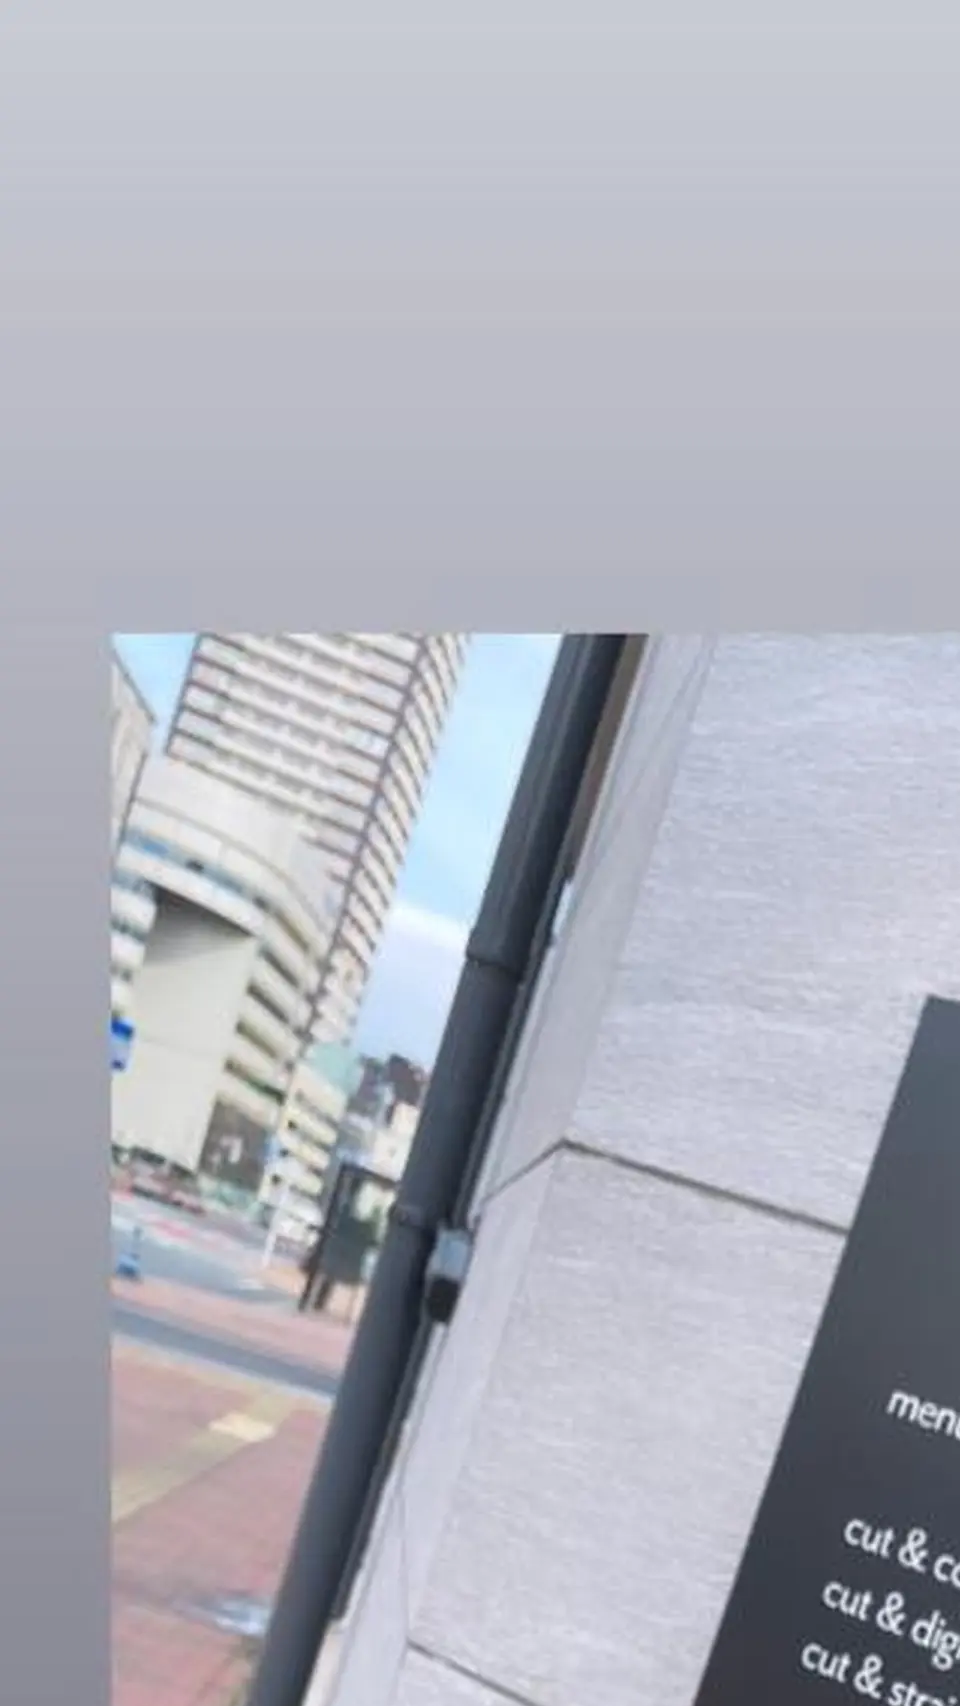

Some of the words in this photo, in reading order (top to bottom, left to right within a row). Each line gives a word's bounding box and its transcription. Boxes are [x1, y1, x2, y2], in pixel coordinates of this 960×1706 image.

[843, 1518, 895, 1558] cut
[897, 1527, 928, 1573] &
[821, 1581, 874, 1622] cut
[876, 1591, 907, 1636] &
[800, 1642, 852, 1683] cut
[853, 1654, 884, 1699] &
